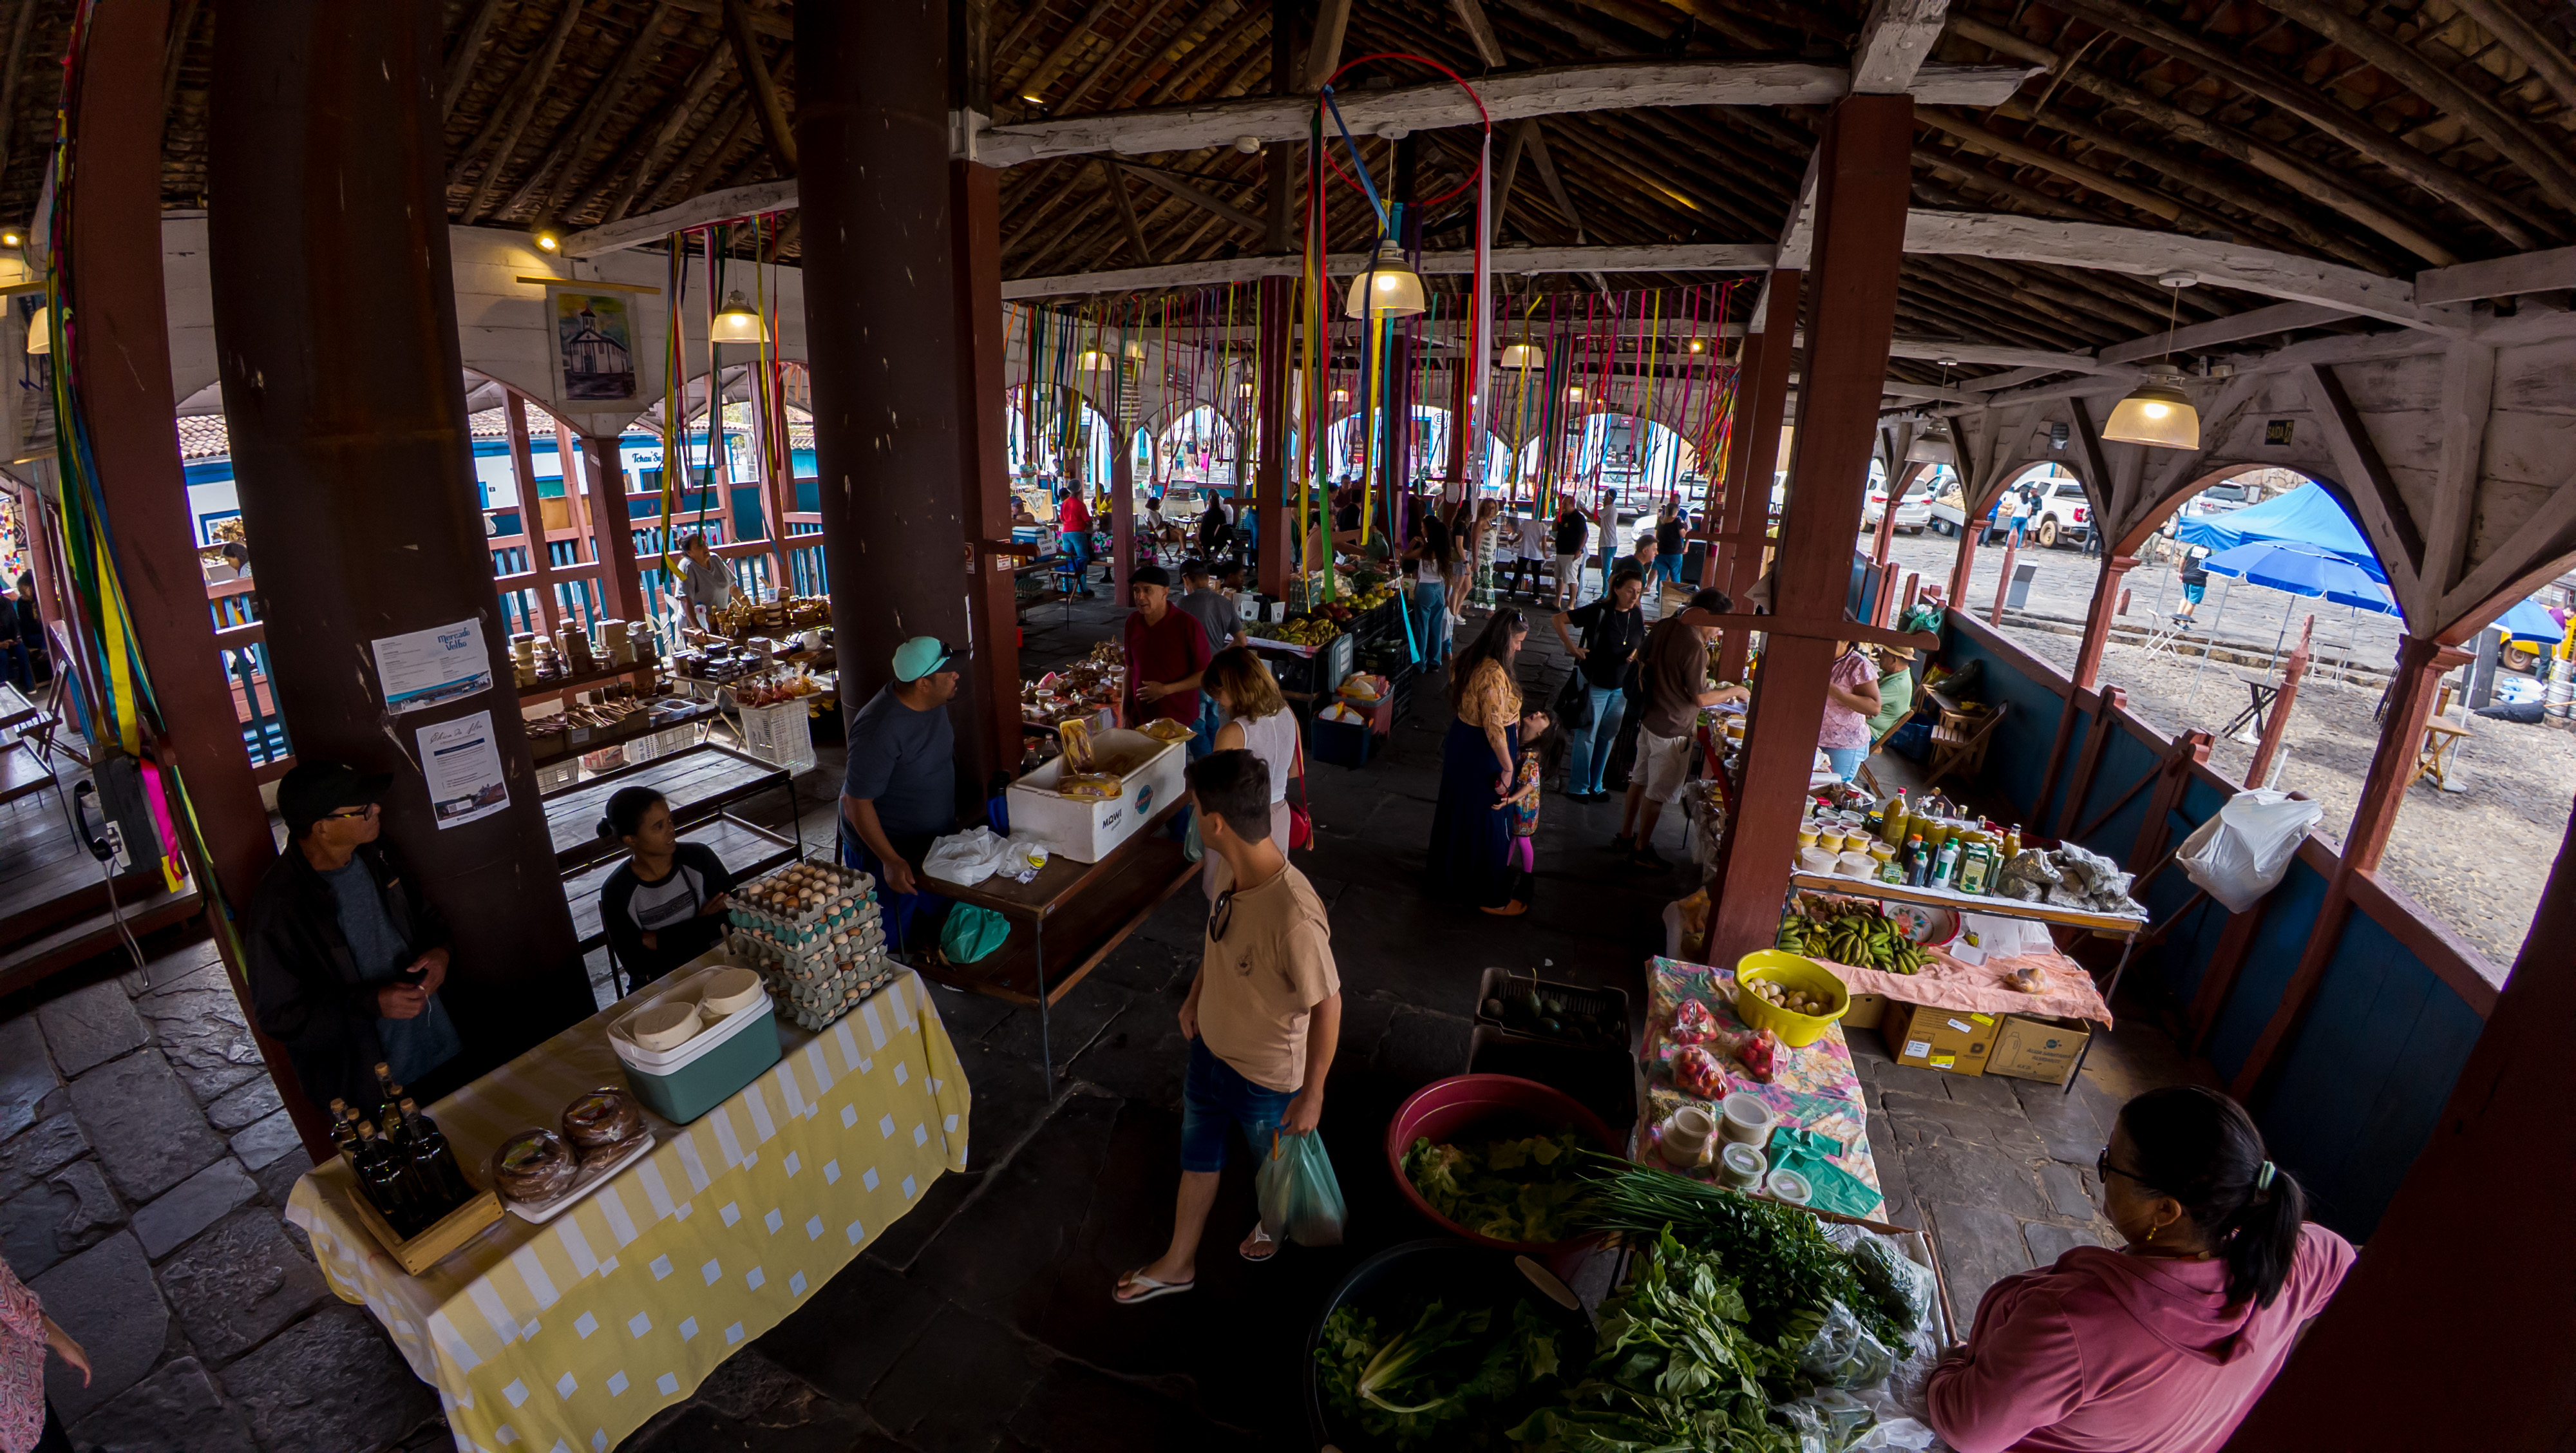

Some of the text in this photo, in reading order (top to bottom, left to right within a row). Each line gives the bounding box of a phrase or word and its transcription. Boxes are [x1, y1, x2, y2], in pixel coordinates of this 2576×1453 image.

[2266, 423, 2284, 439] SAÍDA
[437, 627, 471, 644] Mercado
[446, 639, 468, 651] Velho
